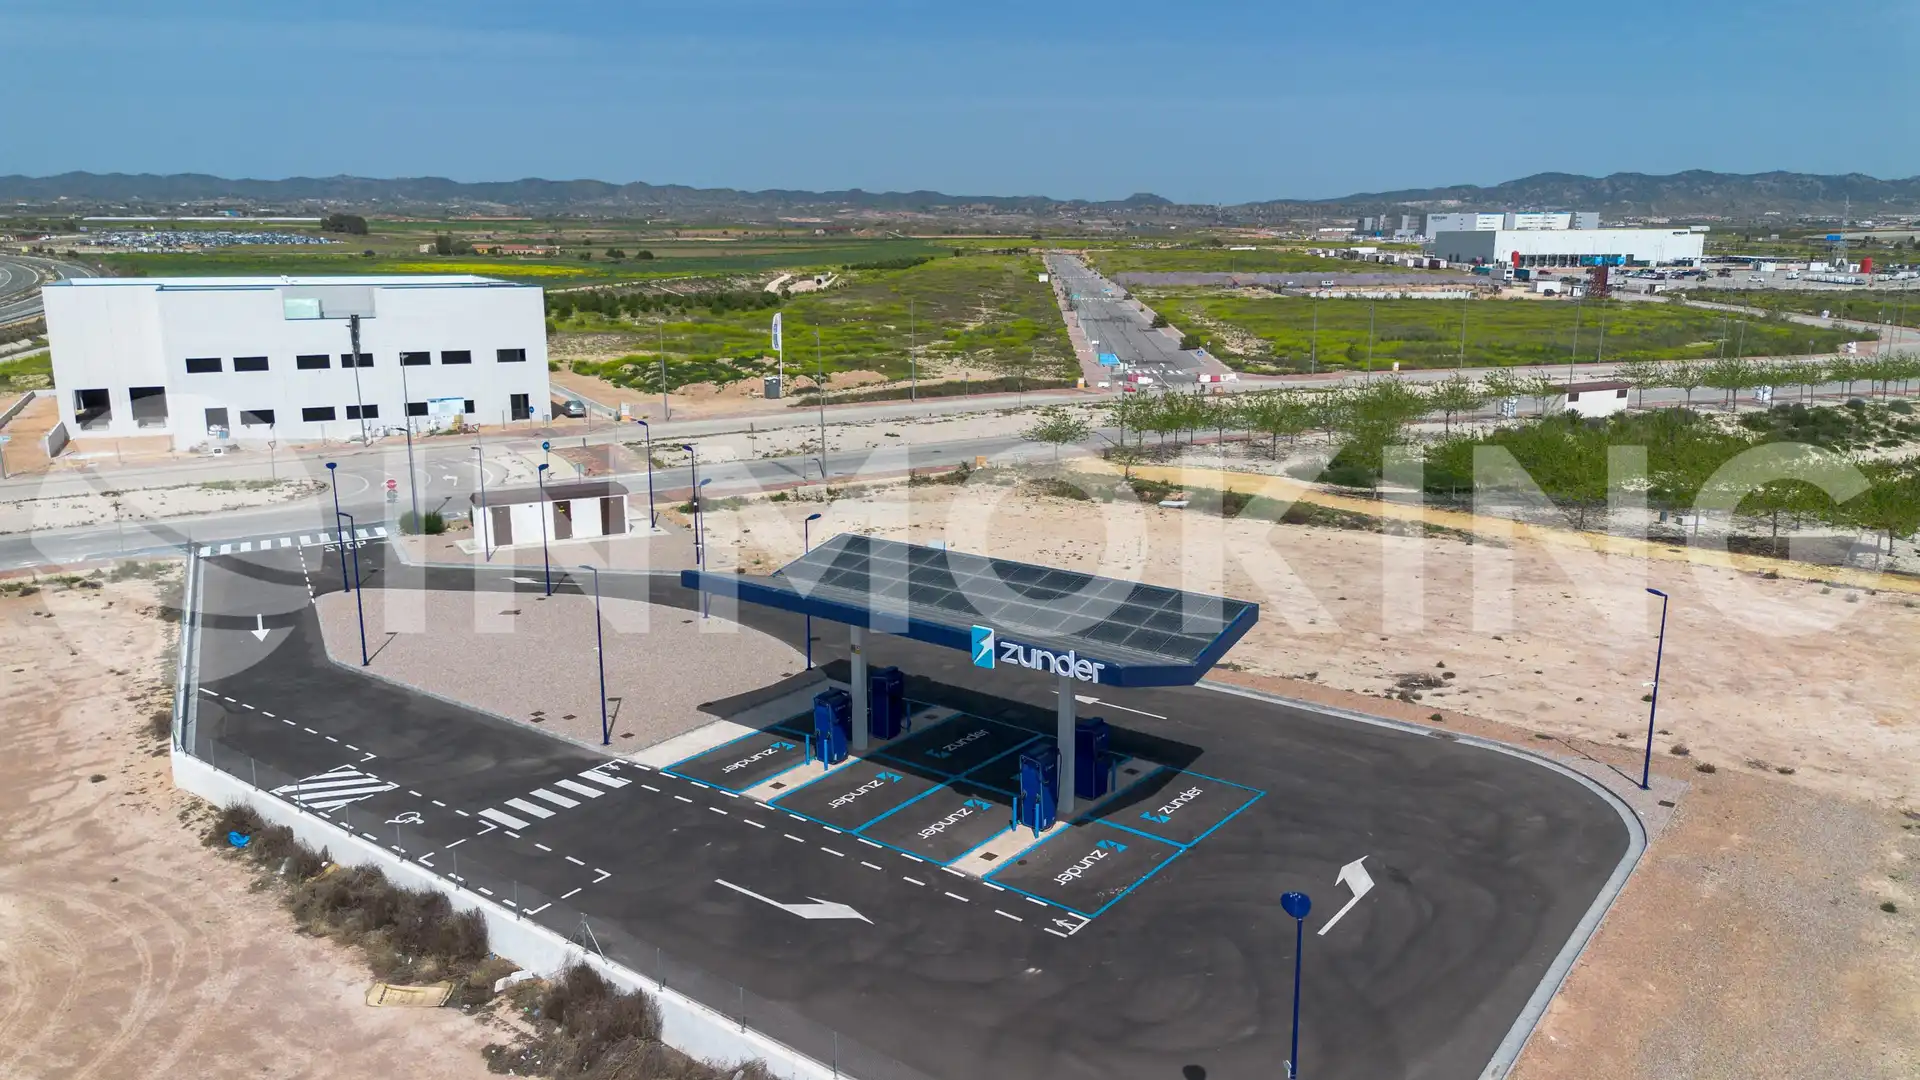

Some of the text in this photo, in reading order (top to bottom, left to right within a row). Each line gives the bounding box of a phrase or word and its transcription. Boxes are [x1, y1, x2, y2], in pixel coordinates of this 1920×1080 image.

[323, 540, 367, 552] STOP
[1000, 641, 1105, 684] zunder
[942, 729, 989, 751] zunder
[722, 748, 778, 774] zunder
[828, 780, 884, 809] zunder
[1158, 786, 1203, 814] zunder
[917, 808, 973, 839] zunder
[1053, 849, 1108, 886] zunder
